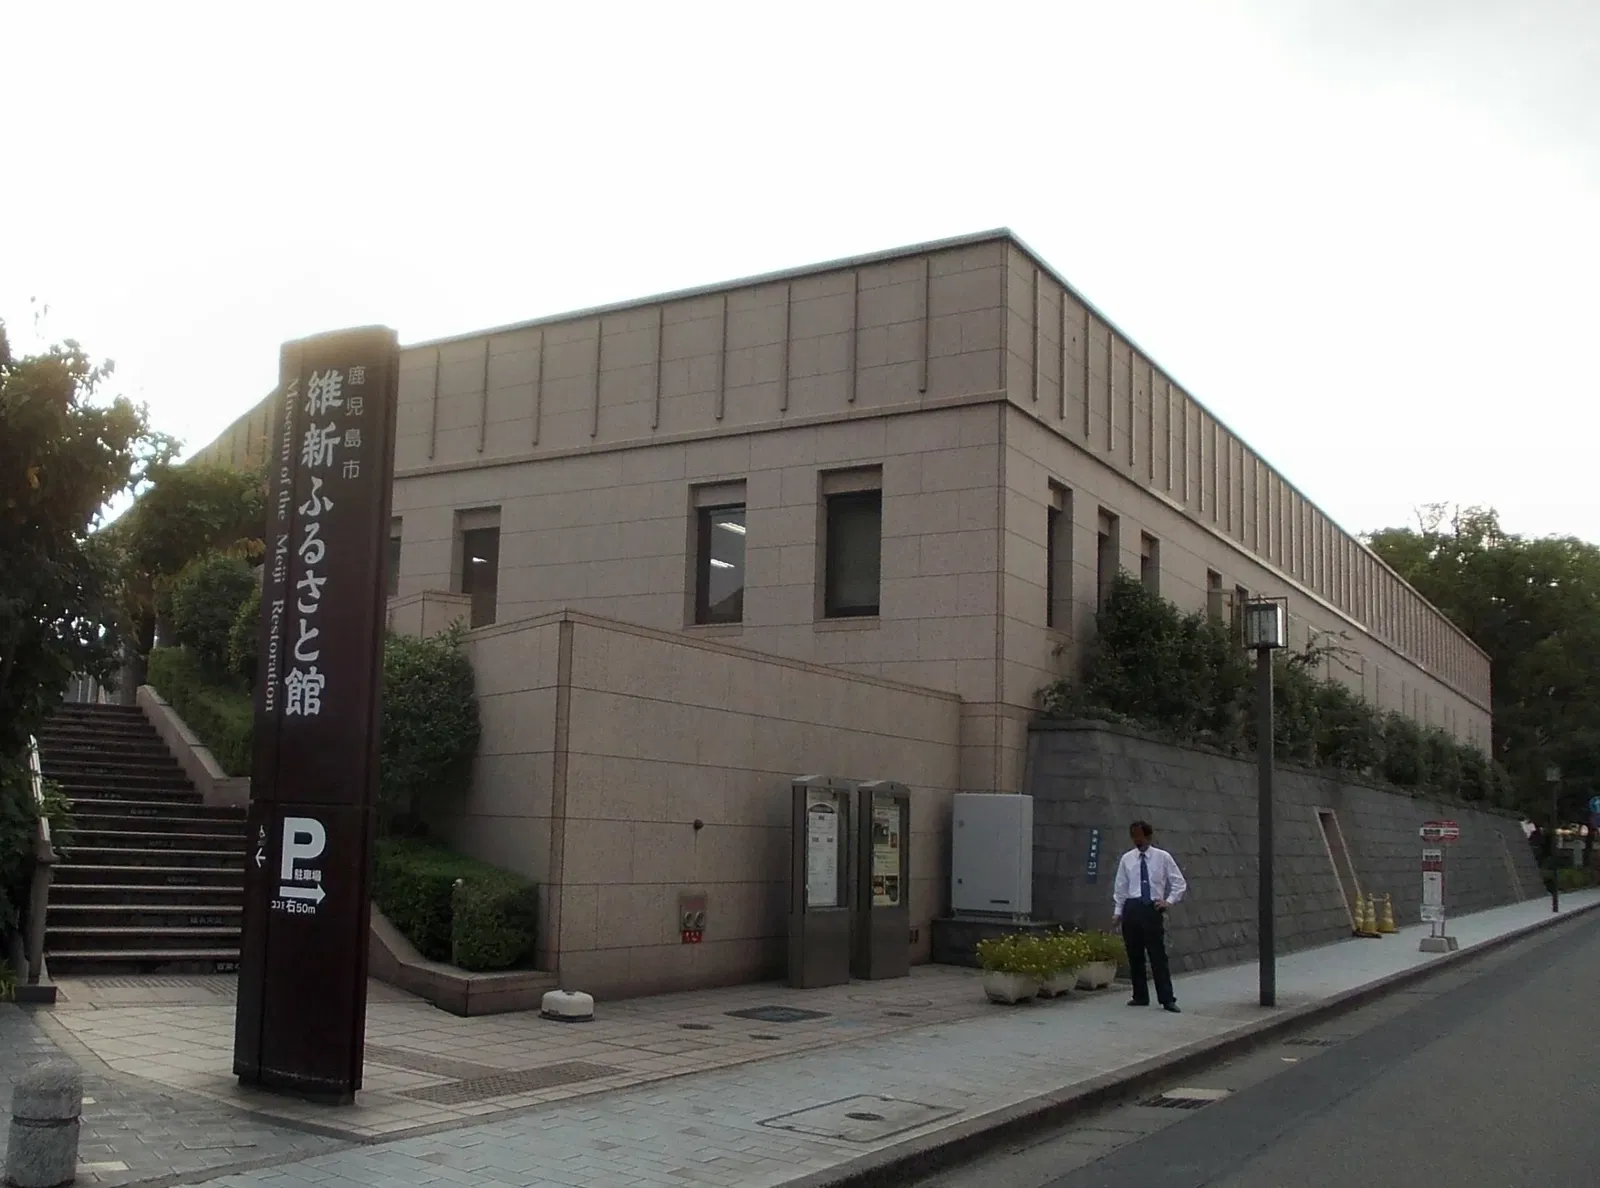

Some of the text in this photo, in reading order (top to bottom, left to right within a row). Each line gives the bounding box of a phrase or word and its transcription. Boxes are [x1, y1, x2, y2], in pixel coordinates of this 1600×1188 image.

[342, 366, 366, 479] 鹿児島市
[265, 378, 301, 712] Museum of the Meiji Restoration
[284, 369, 344, 716] 維新ふるさと館
[281, 817, 326, 880] P
